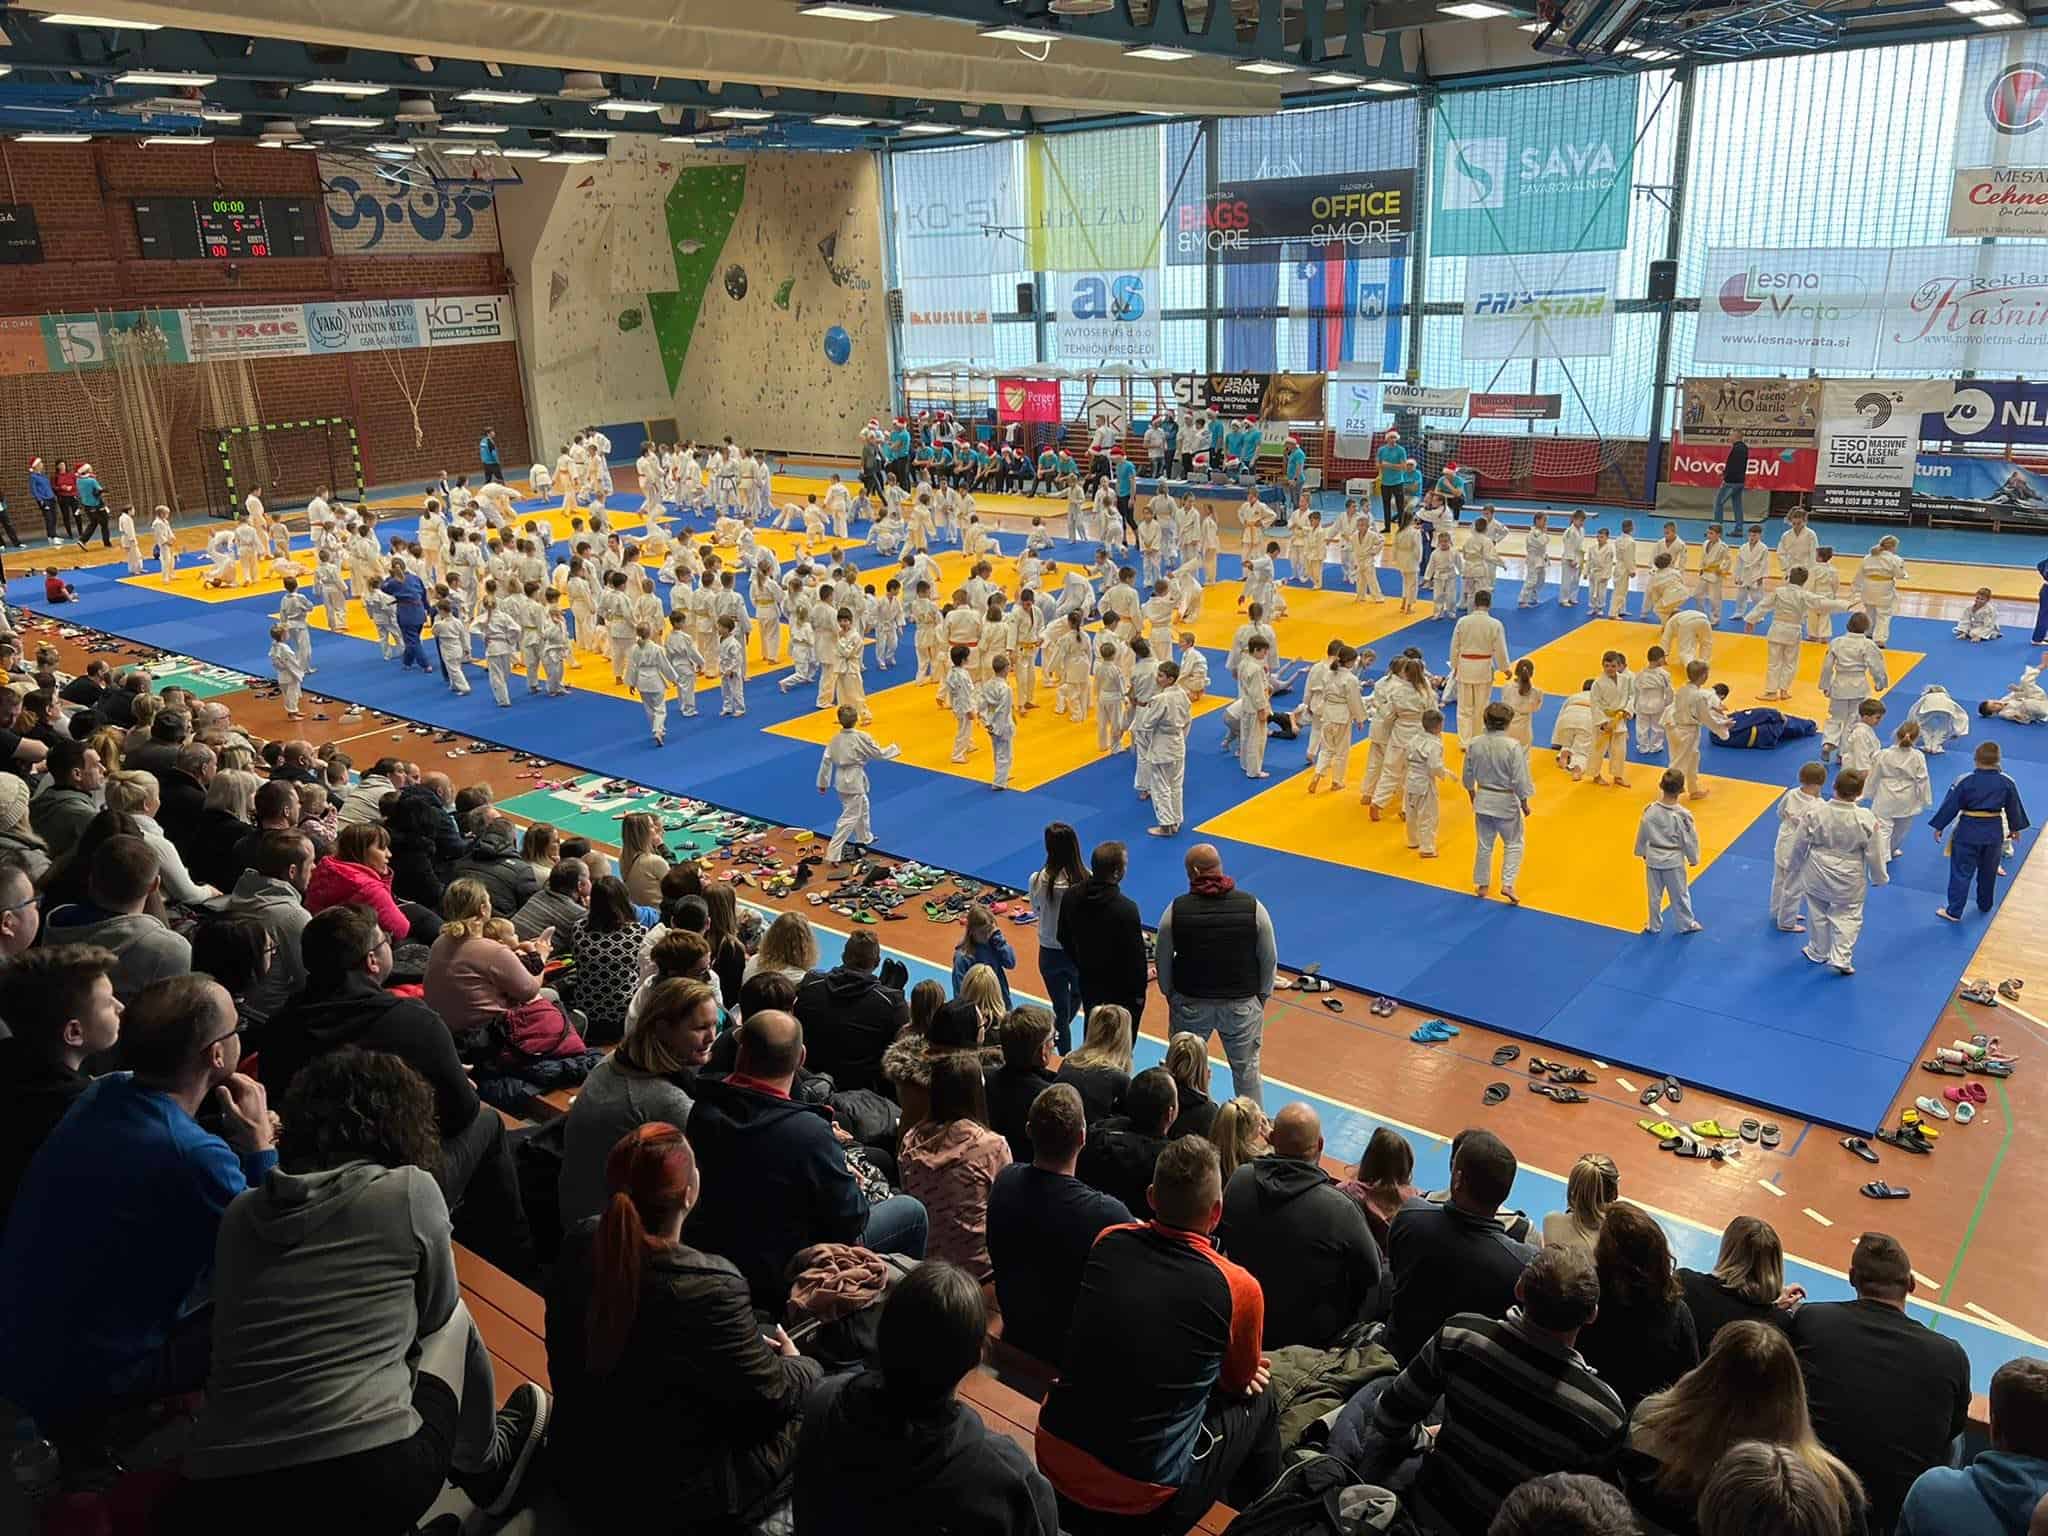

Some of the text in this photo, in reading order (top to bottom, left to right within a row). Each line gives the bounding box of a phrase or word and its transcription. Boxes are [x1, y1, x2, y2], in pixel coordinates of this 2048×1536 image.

[1520, 141, 1618, 180] SAVA
[1994, 171, 2048, 183] MESA
[213, 200, 245, 213] 00:00
[1311, 190, 1400, 219] OFFICE
[1180, 202, 1249, 230] BAGS
[1311, 219, 1401, 247] &MORE
[1178, 229, 1250, 252] &MORE
[212, 245, 228, 257] 00
[251, 244, 266, 256] 00
[1746, 265, 1820, 299] Lesna
[1072, 275, 1145, 321] as
[1771, 294, 1841, 320] Vrata
[426, 303, 499, 326] KO-SI
[316, 316, 343, 332] VAKO
[1721, 334, 1851, 348] www.lesna-vrata.si
[1223, 385, 1260, 395] PRINT
[1384, 384, 1427, 398] KOMOT
[1756, 390, 1787, 401] leseno
[1027, 391, 1056, 405] Perger
[1713, 389, 1755, 413] MG
[1755, 400, 1785, 412] darilo
[1831, 439, 1868, 451] LESO
[1868, 440, 1907, 448] MASIVNE
[1830, 452, 1865, 464] TEKA
[1868, 449, 1899, 457] LESENE
[1744, 459, 1780, 477] BM
